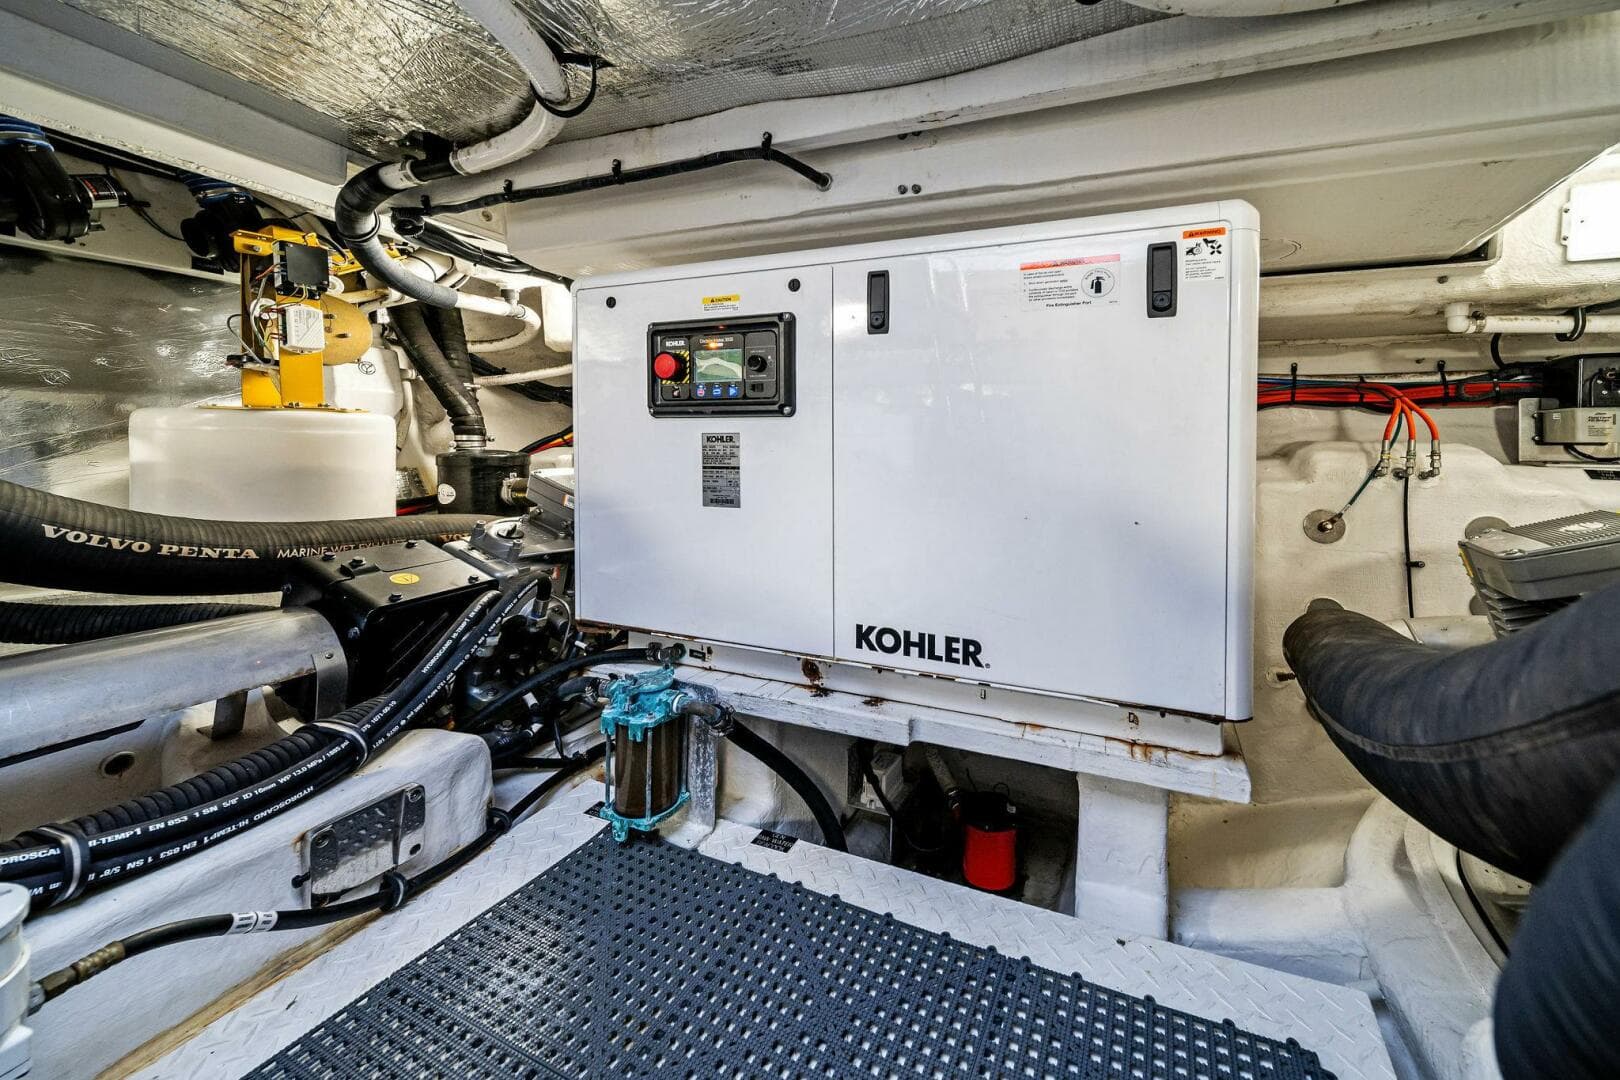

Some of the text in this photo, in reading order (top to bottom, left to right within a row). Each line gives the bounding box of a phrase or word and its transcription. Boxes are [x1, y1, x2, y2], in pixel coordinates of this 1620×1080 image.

[706, 435, 733, 443] KOHLER
[41, 523, 260, 559] VOLVO PENTA
[276, 546, 328, 558] MARINE
[421, 639, 453, 674] HYDROSCAND
[855, 623, 984, 668] KOHLER
[149, 823, 165, 832] EN
[168, 816, 188, 826] 853
[202, 805, 219, 815] SN
[242, 792, 253, 800] ID
[278, 775, 292, 784] WP
[253, 785, 315, 821] HYDROSCAND
[203, 818, 249, 844] HI-TEMP1
[160, 847, 181, 859] 853
[182, 840, 198, 850] EN
[126, 859, 144, 870] SN
